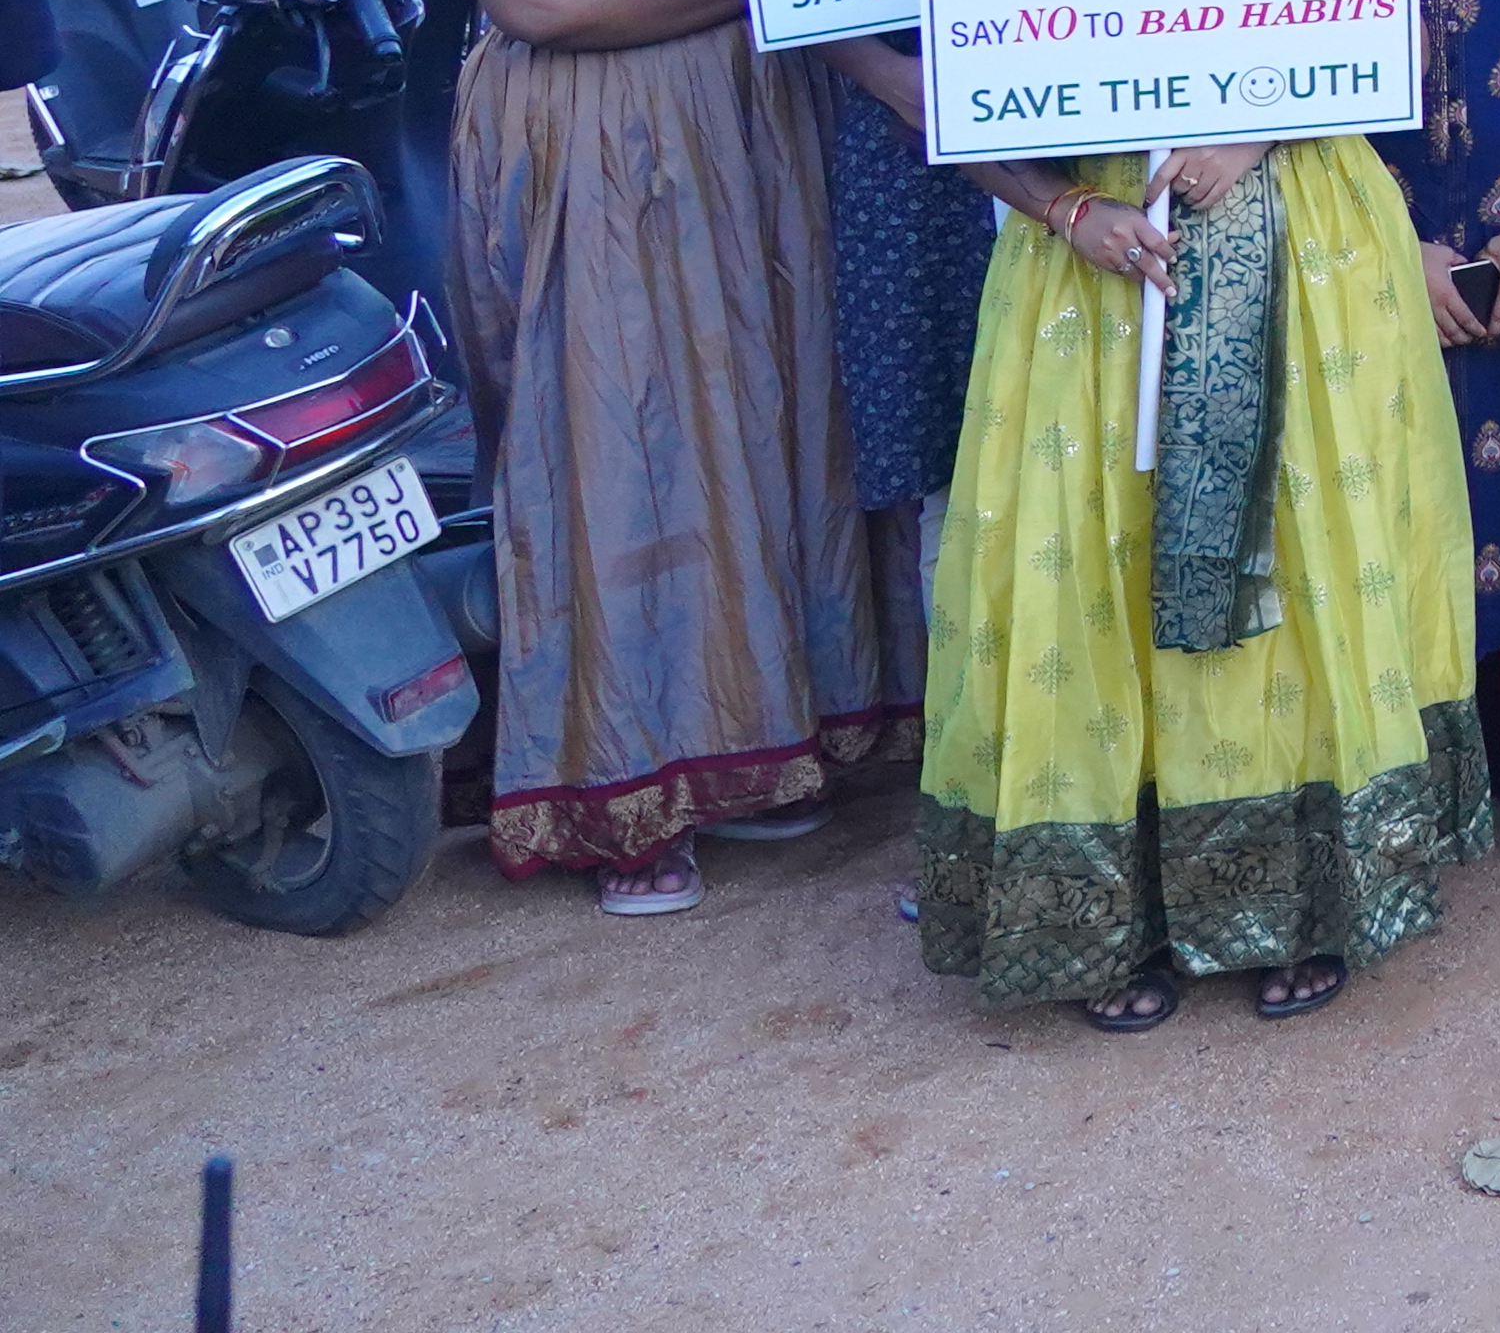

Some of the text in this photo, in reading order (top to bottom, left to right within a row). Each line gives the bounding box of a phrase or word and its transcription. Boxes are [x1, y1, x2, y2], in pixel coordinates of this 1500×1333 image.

[950, 18, 1010, 48] SAY
[1011, 5, 1078, 44] NO
[1083, 10, 1124, 39] TO
[1135, 4, 1225, 35] BAD
[970, 82, 1081, 122] SAVE
[1099, 74, 1190, 112] THE
[277, 469, 404, 559] AP39J
[261, 563, 285, 581] IND
[290, 509, 420, 595] V7750
